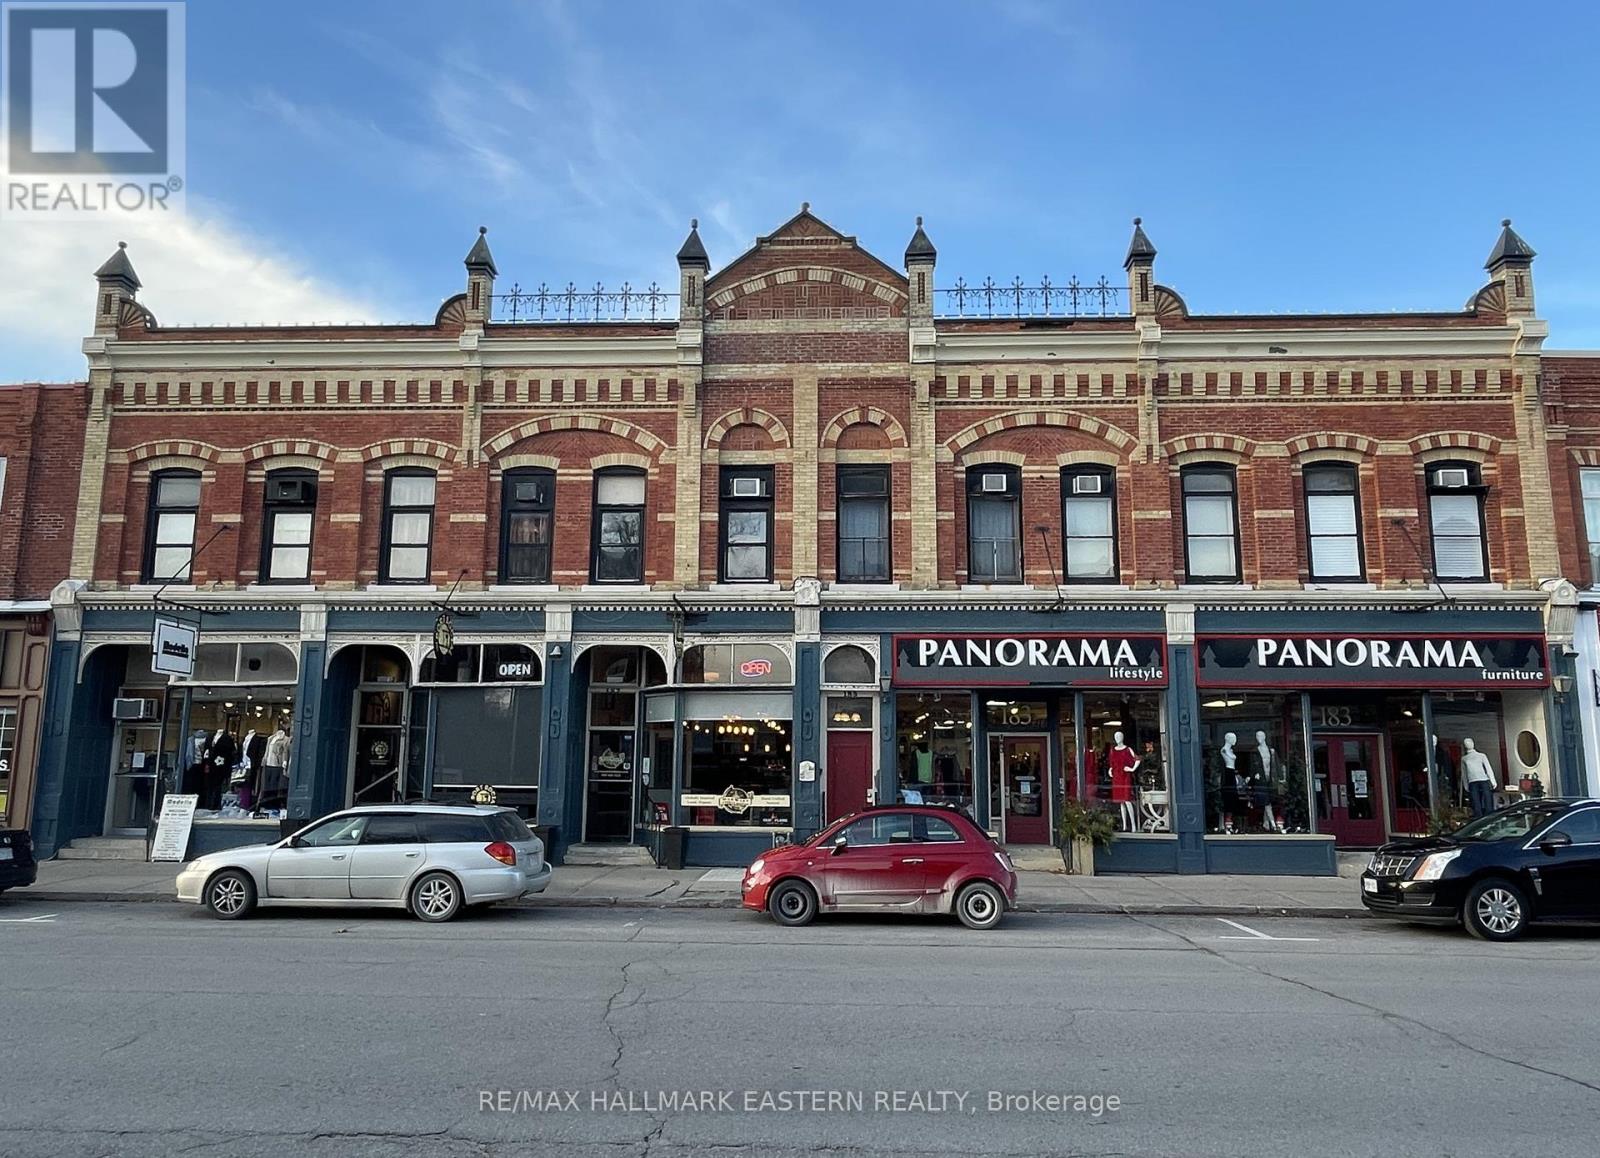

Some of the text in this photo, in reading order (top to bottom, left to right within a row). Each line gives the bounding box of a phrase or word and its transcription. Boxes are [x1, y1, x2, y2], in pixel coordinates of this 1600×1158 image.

[919, 638, 1138, 667] PANORAMA
[1257, 638, 1485, 668] PANORAMA
[499, 663, 531, 676] OPEN
[741, 662, 771, 674] OPEN
[1109, 667, 1163, 681] lifestyle
[1482, 669, 1544, 680] furniture
[1001, 705, 1032, 725] 183
[1320, 706, 1352, 727] 183
